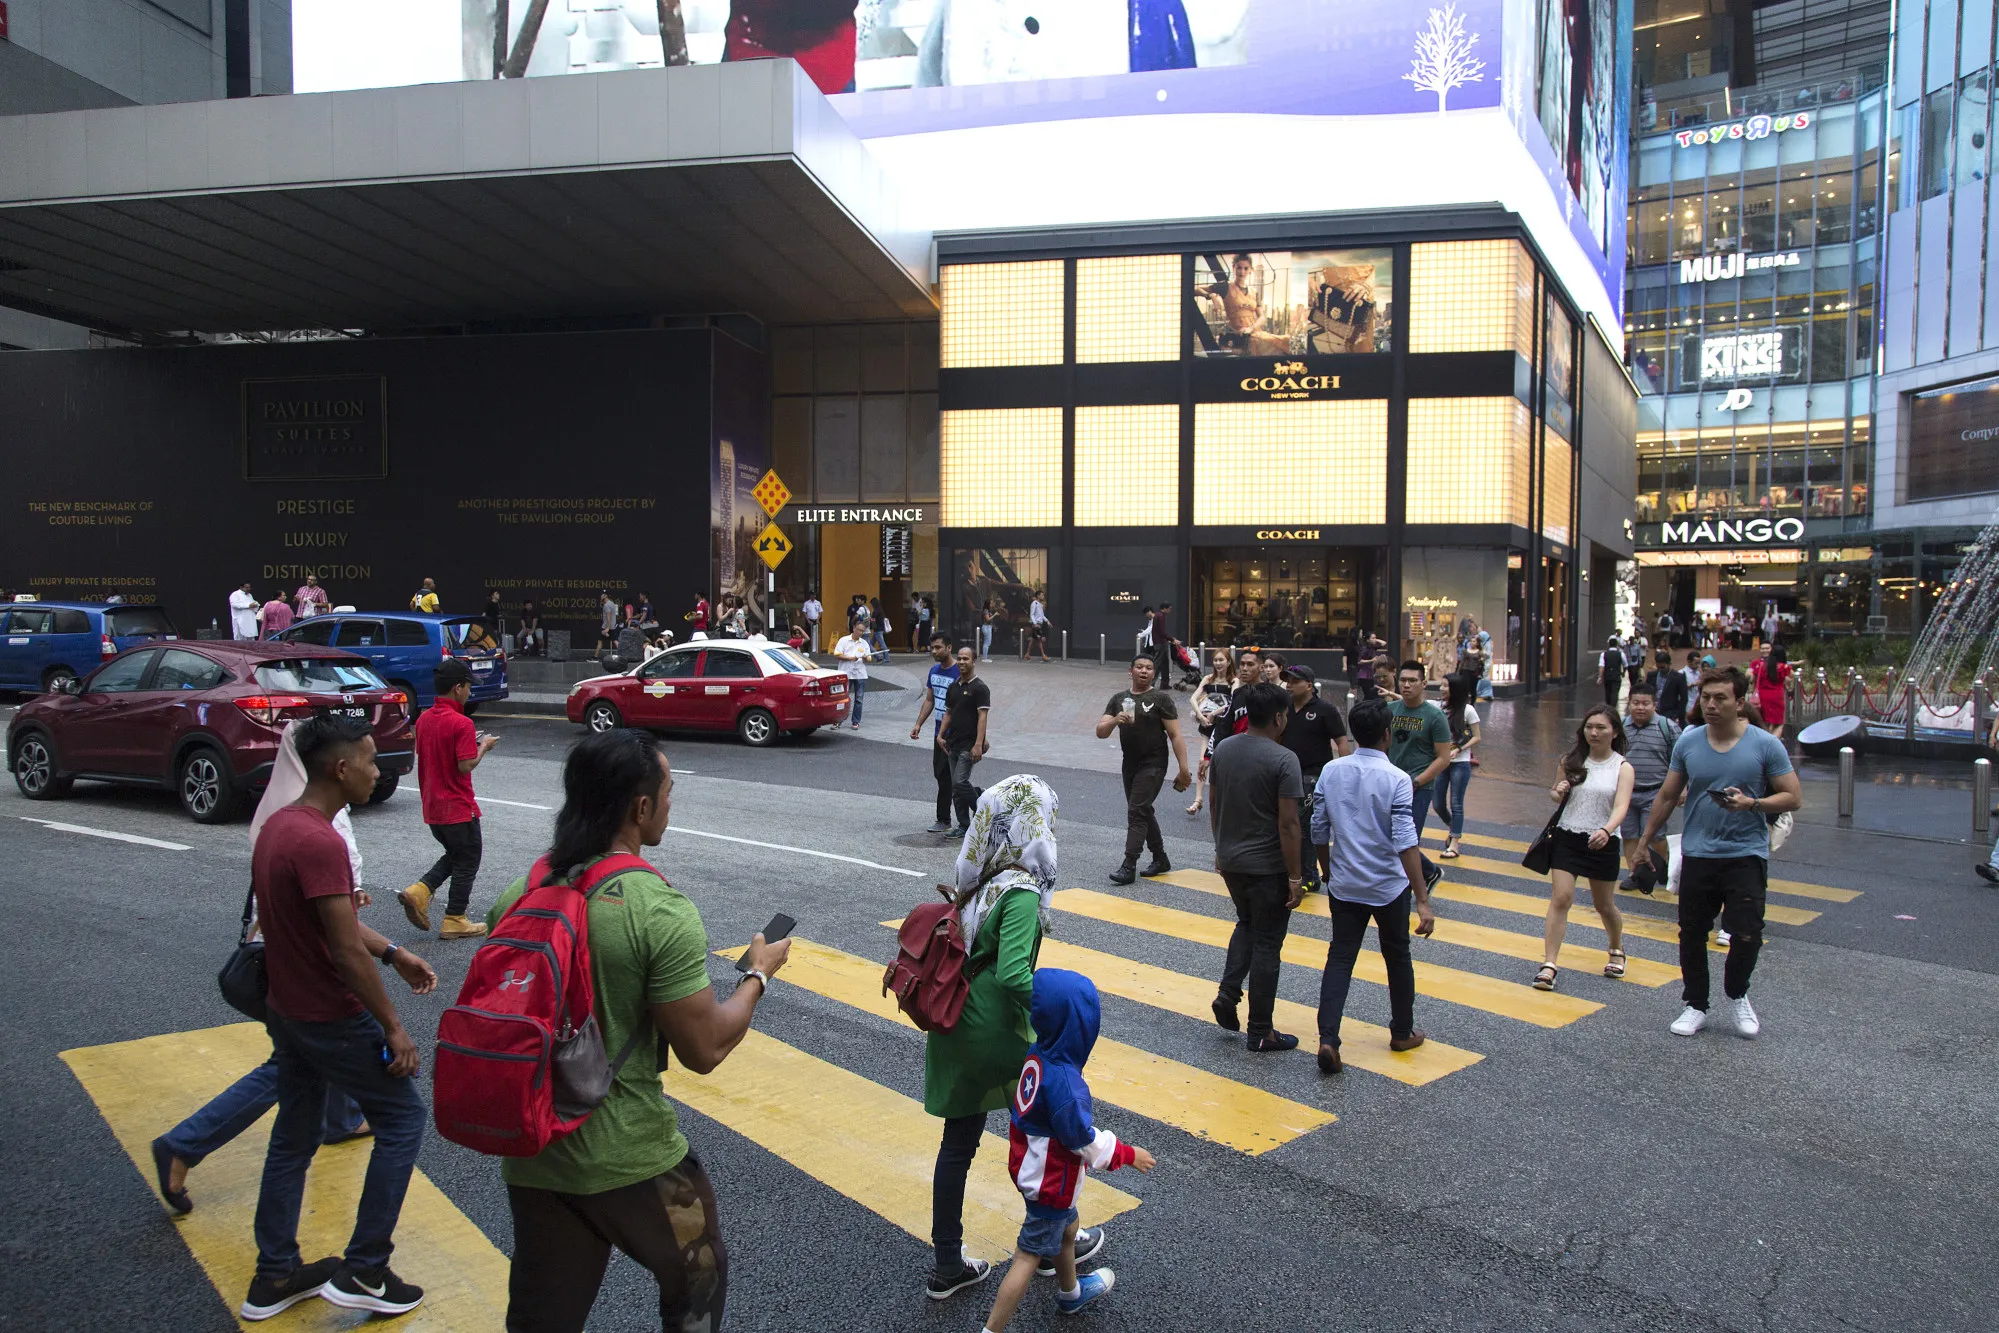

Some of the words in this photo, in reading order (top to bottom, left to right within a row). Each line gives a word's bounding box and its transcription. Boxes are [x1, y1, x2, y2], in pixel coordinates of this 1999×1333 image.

[1680, 253, 1745, 283] MUJI
[1701, 342, 1782, 369] KING
[1240, 375, 1341, 391] COACH
[1717, 388, 1753, 411] JD
[263, 400, 364, 419] PAVILION
[277, 429, 351, 441] SUITES
[29, 502, 47, 512] THE
[50, 502, 71, 512] NEW
[74, 502, 136, 512] BENCHMARK
[139, 502, 153, 511] OF
[277, 499, 355, 514] PRESTIGE
[458, 498, 509, 509] ANOTHER
[512, 498, 584, 509] PRESTIGIOUS
[587, 498, 638, 509] PROJECT
[641, 498, 656, 509] BY
[49, 515, 96, 525] COUTURE
[98, 515, 133, 525] LIVING
[497, 513, 518, 523] THE
[521, 513, 571, 523] PAVILION
[575, 513, 615, 523] GROUP
[797, 509, 836, 522] ELITE
[841, 508, 923, 522] ENTRANCE
[1256, 530, 1320, 540] COACH
[1662, 517, 1804, 543] MANGO
[284, 532, 348, 547] LUXURY
[1751, 551, 1841, 562] CONNECON
[263, 564, 371, 579] DISTINCTION
[29, 577, 62, 586] LUXURY
[65, 577, 99, 586] PRIVATE
[102, 577, 156, 586] RESIDENCES
[485, 579, 522, 589] LUXURY
[525, 579, 564, 589] PRIVATE
[567, 579, 628, 589] RESIDENCES
[570, 598, 597, 608] 2028
[345, 708, 365, 717] 7248
